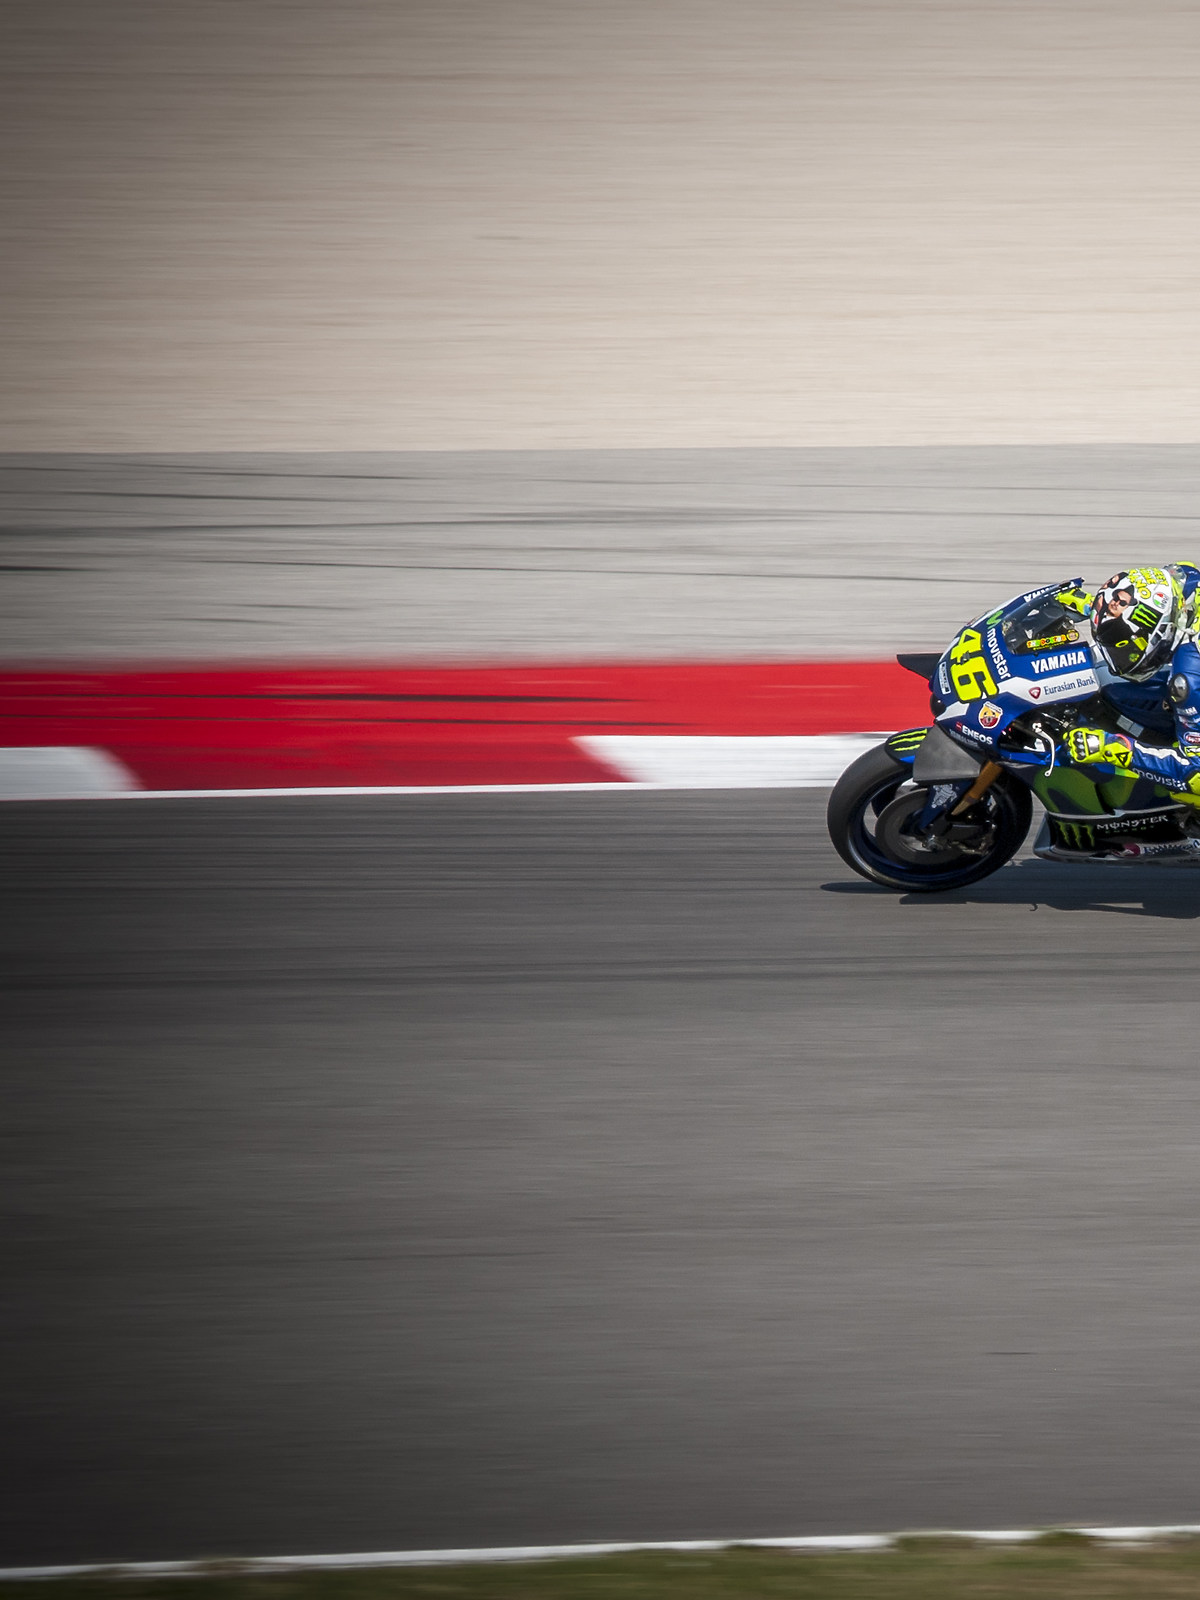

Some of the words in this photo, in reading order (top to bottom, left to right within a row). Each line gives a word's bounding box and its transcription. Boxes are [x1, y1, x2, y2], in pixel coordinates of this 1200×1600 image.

[986, 627, 1011, 680] movistar
[1030, 651, 1087, 674] YAMAHA
[950, 628, 998, 702] 46
[1043, 682, 1076, 695] Eurasian
[1076, 676, 1096, 688] Bank
[962, 725, 993, 745] ENEOS
[1096, 814, 1169, 830] MONSTER
